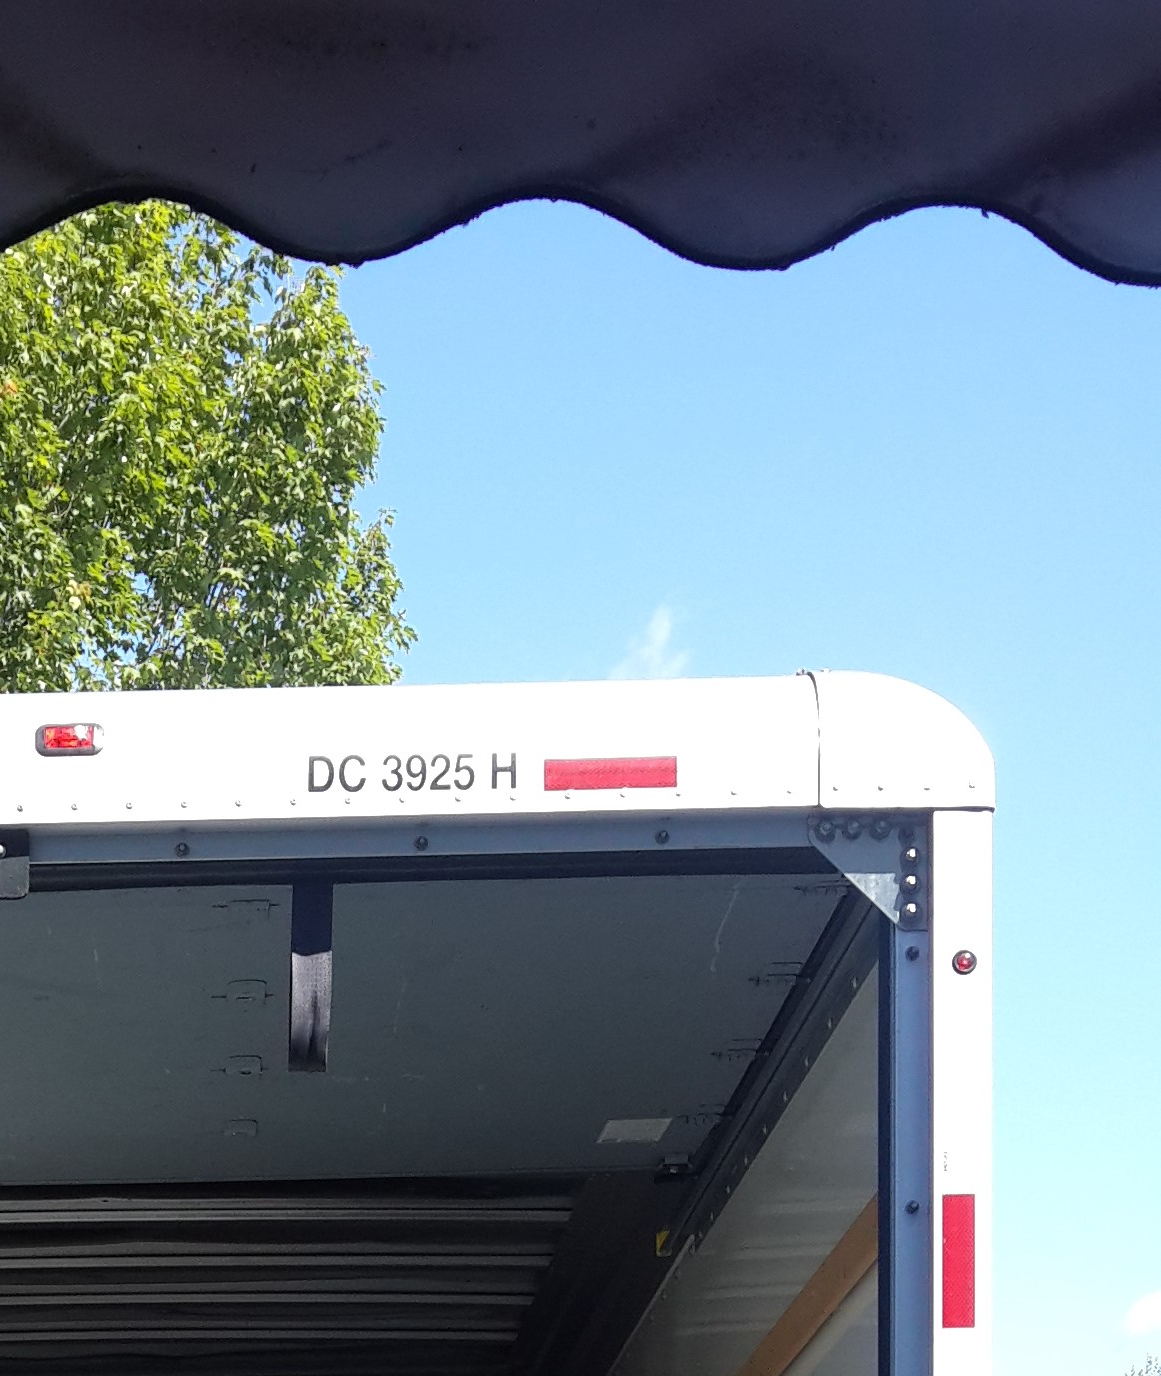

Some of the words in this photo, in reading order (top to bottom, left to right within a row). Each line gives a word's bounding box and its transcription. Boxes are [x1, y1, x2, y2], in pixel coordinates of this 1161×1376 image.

[308, 755, 366, 793] DC
[381, 753, 475, 791] 3925
[491, 752, 517, 789] H
